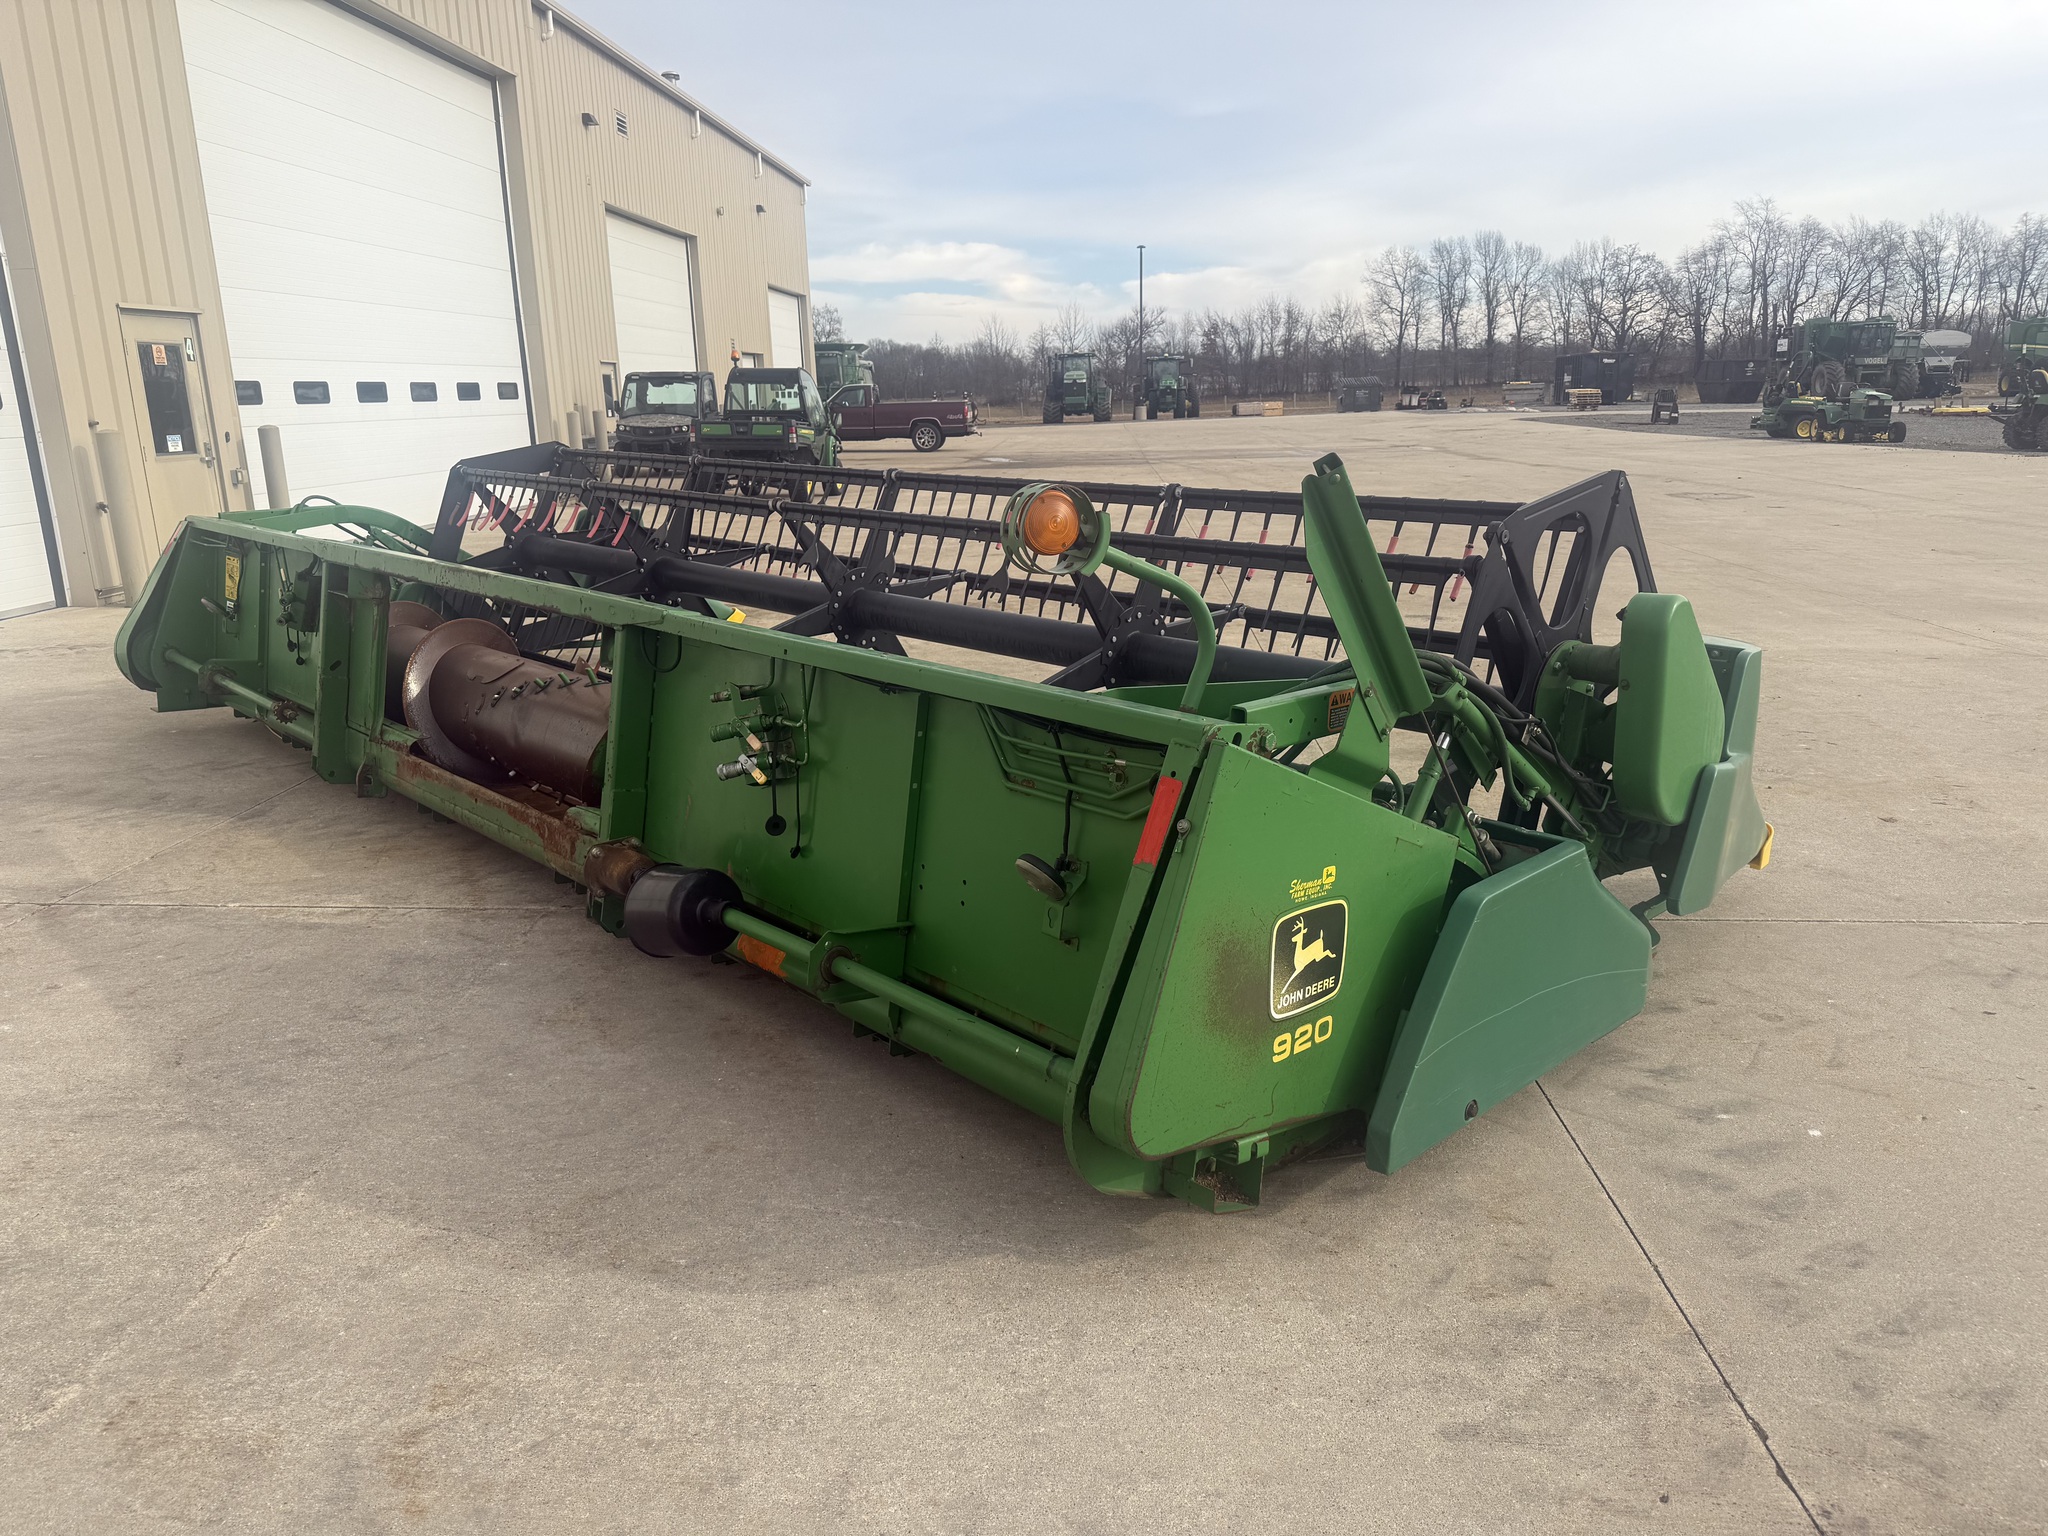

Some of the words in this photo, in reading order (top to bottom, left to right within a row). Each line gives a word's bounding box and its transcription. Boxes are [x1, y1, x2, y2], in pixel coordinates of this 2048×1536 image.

[186, 338, 195, 361] 4
[1289, 879, 1323, 893] Sherman
[1291, 890, 1305, 899] FARM
[1277, 988, 1304, 1010] JOHN
[1305, 975, 1336, 999] DEERE
[1272, 1015, 1333, 1063] 920
